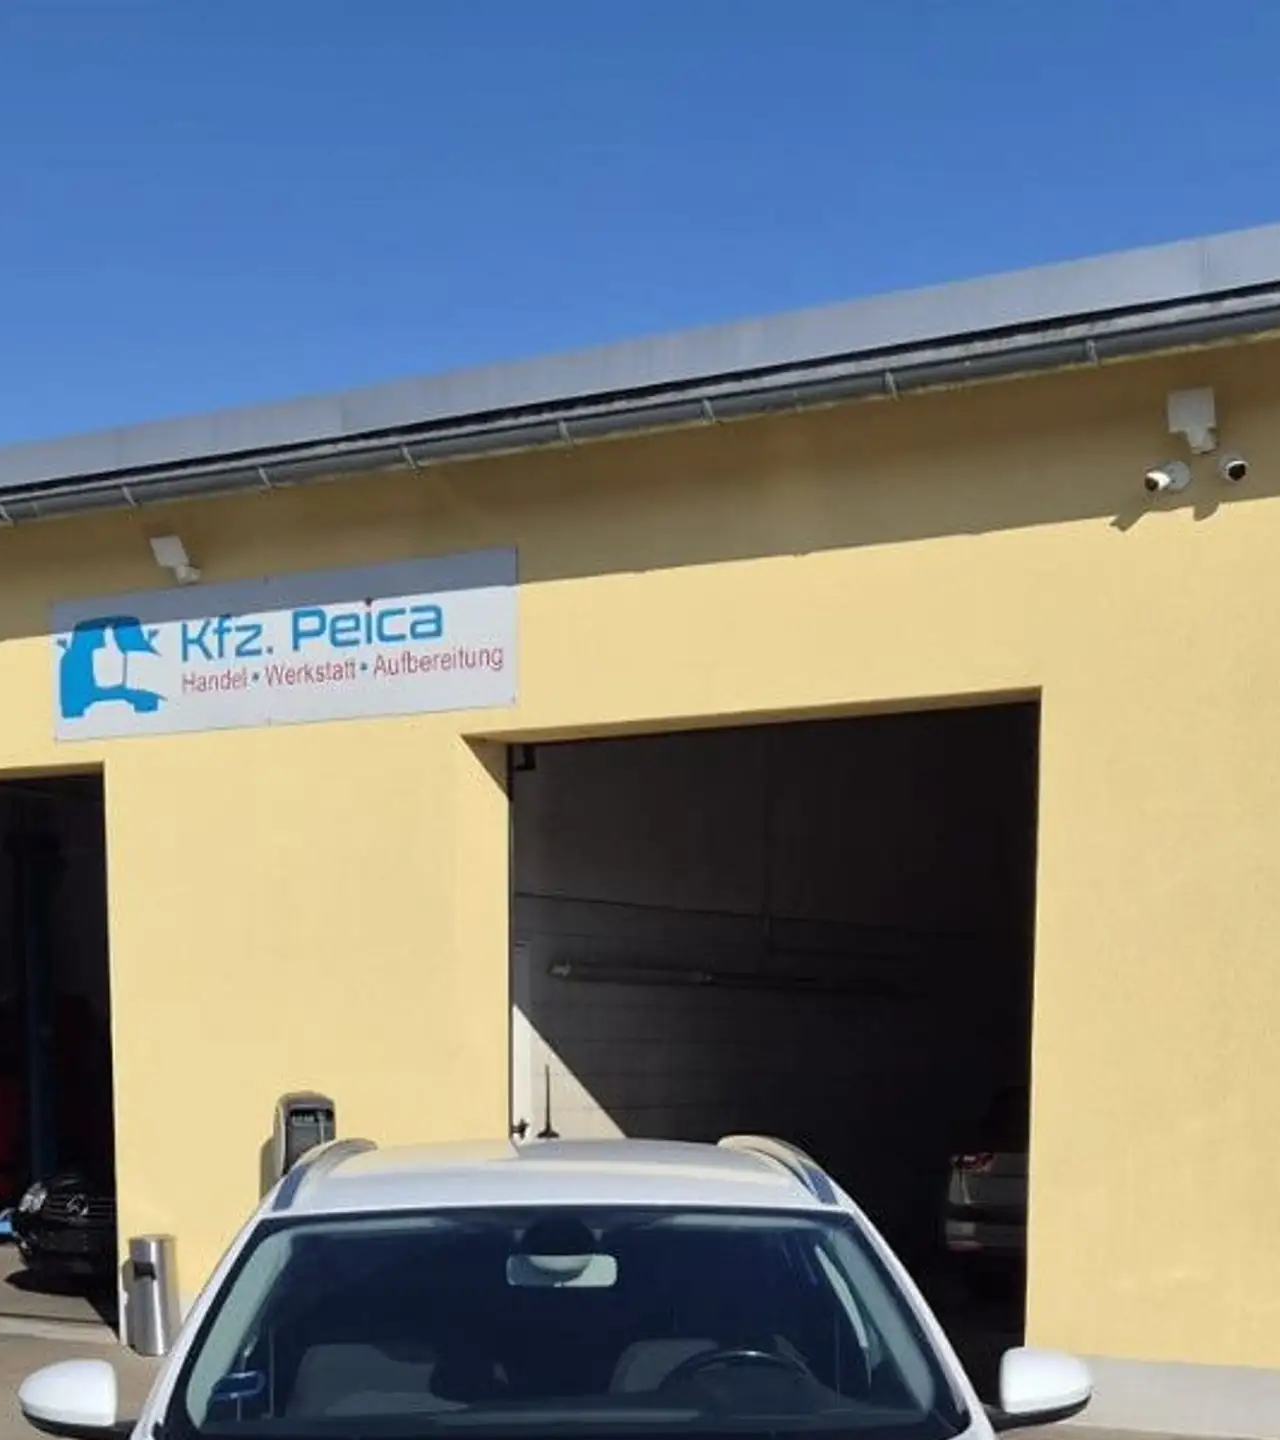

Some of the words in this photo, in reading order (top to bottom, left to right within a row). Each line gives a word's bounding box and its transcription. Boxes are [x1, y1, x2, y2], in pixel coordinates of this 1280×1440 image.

[181, 614, 273, 662] Kfz.
[291, 597, 443, 650] Peica
[181, 666, 248, 692] Handel
[264, 657, 356, 687] Werkstatt
[372, 643, 505, 676] Aufbereitung
